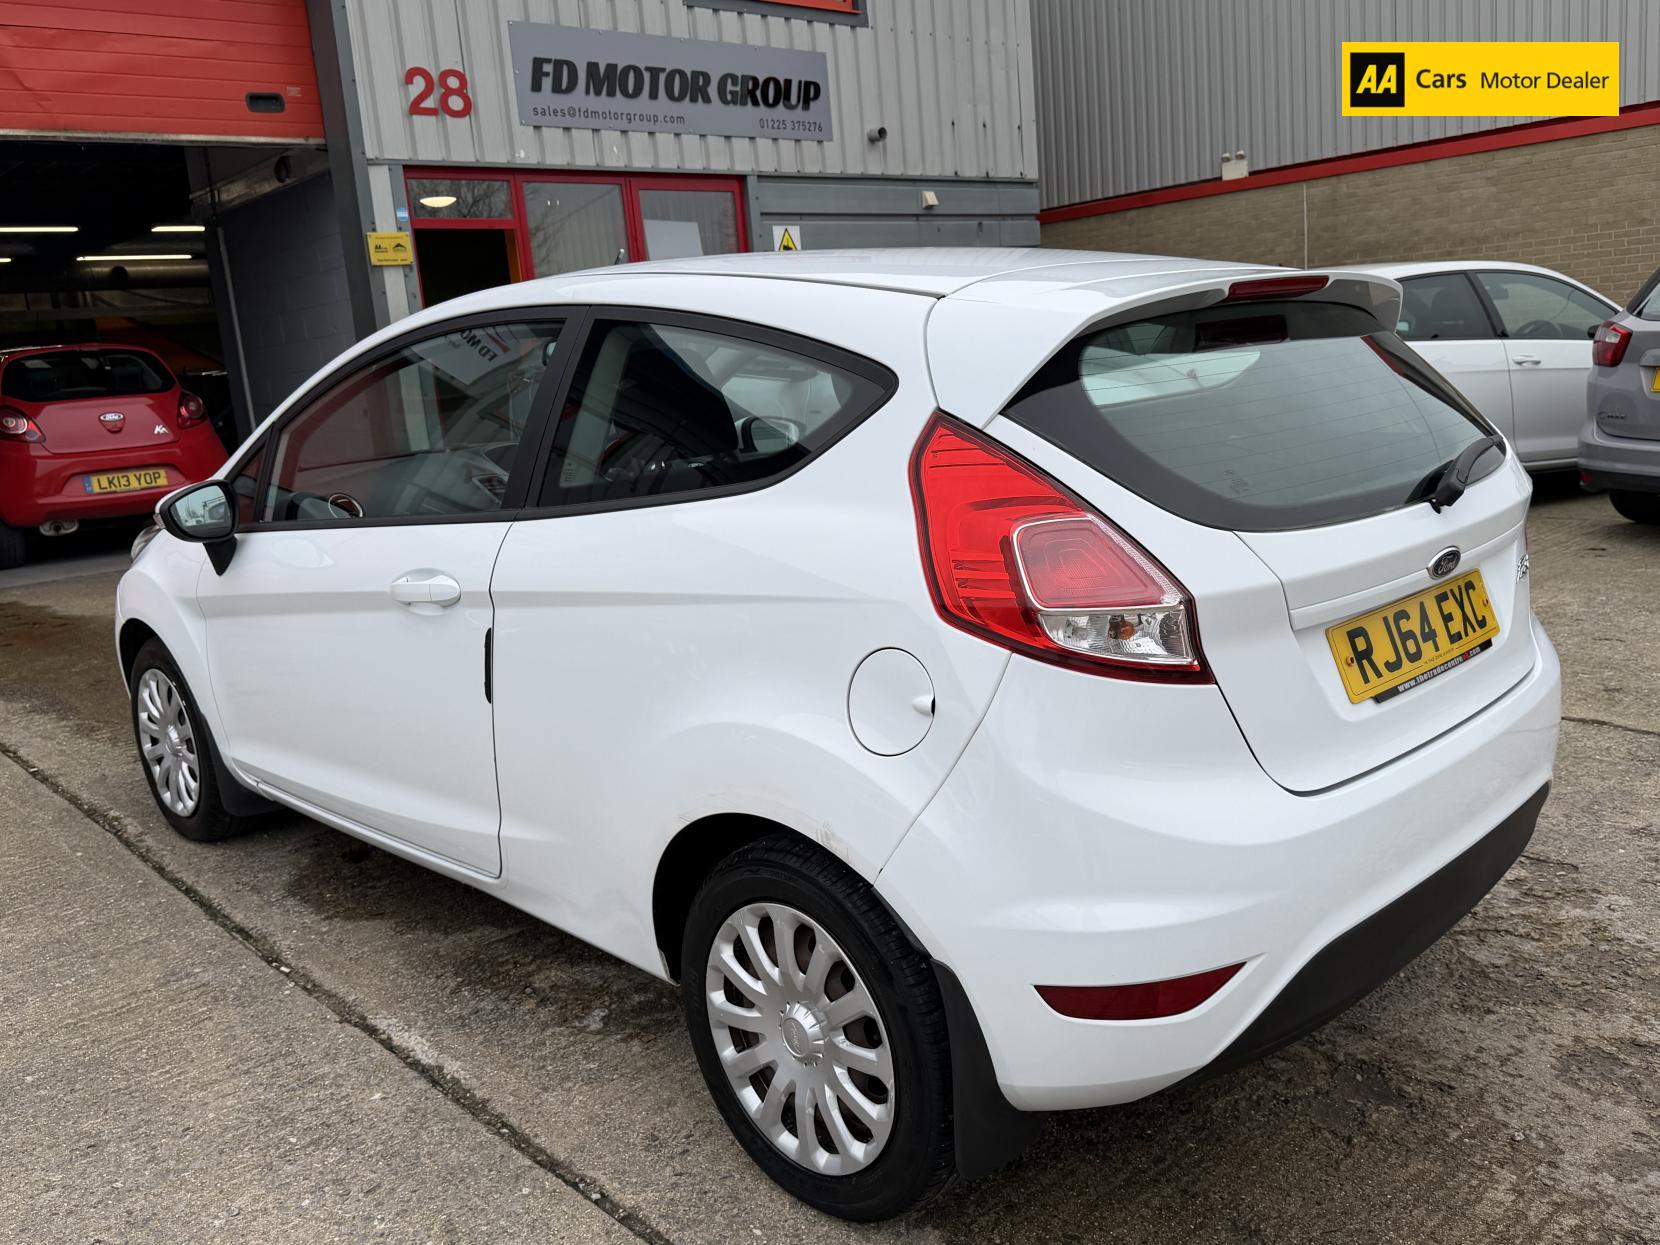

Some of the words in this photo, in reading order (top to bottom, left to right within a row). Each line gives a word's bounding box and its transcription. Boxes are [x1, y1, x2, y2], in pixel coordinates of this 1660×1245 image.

[404, 66, 473, 118] 28
[530, 57, 578, 94] FD
[585, 61, 712, 104] MOTOR
[717, 73, 821, 112] GROUP
[532, 105, 686, 125] sales@fdmotorgroup.com
[759, 118, 787, 130] 01225
[790, 120, 823, 132] 375276
[97, 475, 131, 490] LK13
[133, 471, 161, 486] YOP
[1346, 600, 1441, 684] RJ64
[1435, 580, 1487, 645] EXC
